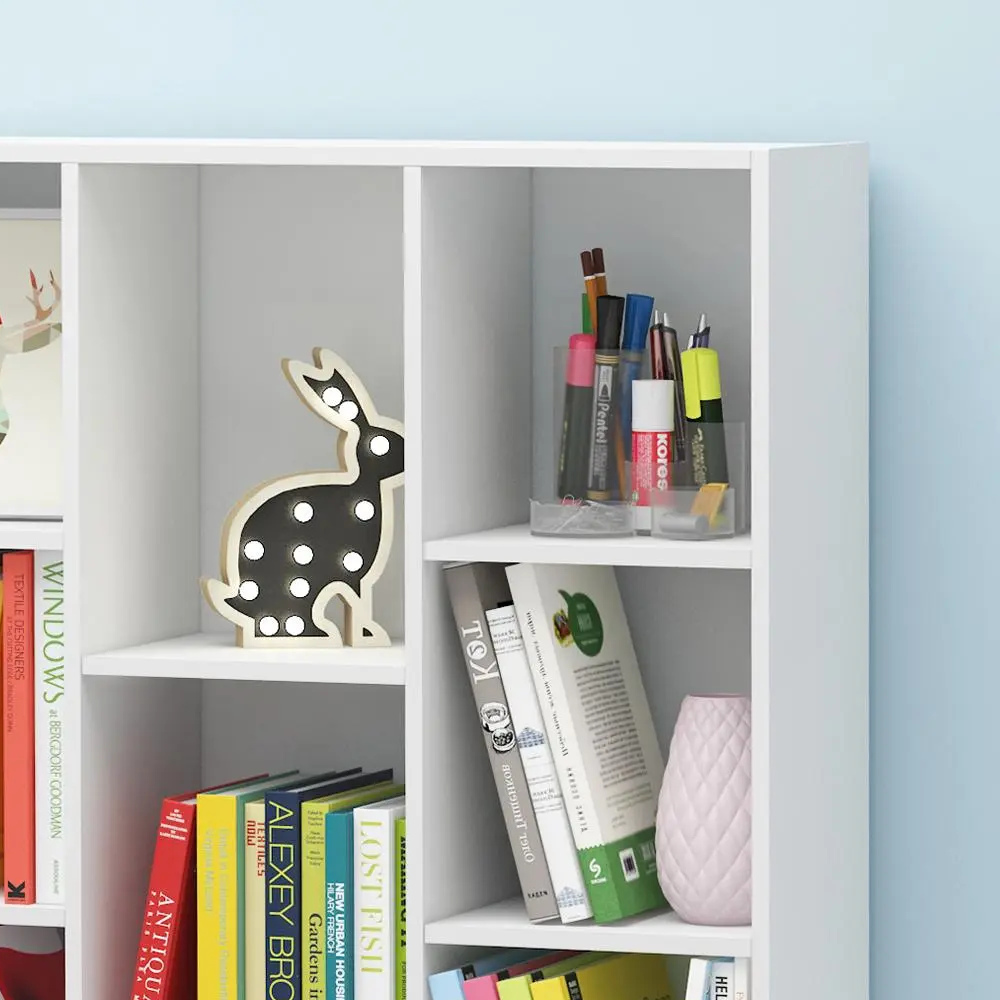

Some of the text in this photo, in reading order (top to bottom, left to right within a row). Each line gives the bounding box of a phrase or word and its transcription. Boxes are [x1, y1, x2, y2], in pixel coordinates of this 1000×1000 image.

[596, 400, 610, 445] Pentel
[13, 574, 25, 681] TEXTILE DESIGNERS
[42, 561, 65, 839] WINDOWS at BERGDORF GOODMAN
[269, 800, 294, 926] ALEXEY
[335, 883, 345, 913] NEW
[360, 822, 383, 973] LOST FISH
[144, 890, 156, 936] PARIS
[309, 913, 323, 984] Gardens
[327, 883, 335, 954] HILARY FRENCH
[335, 914, 345, 959] URBAN
[137, 947, 148, 982] FLEA
